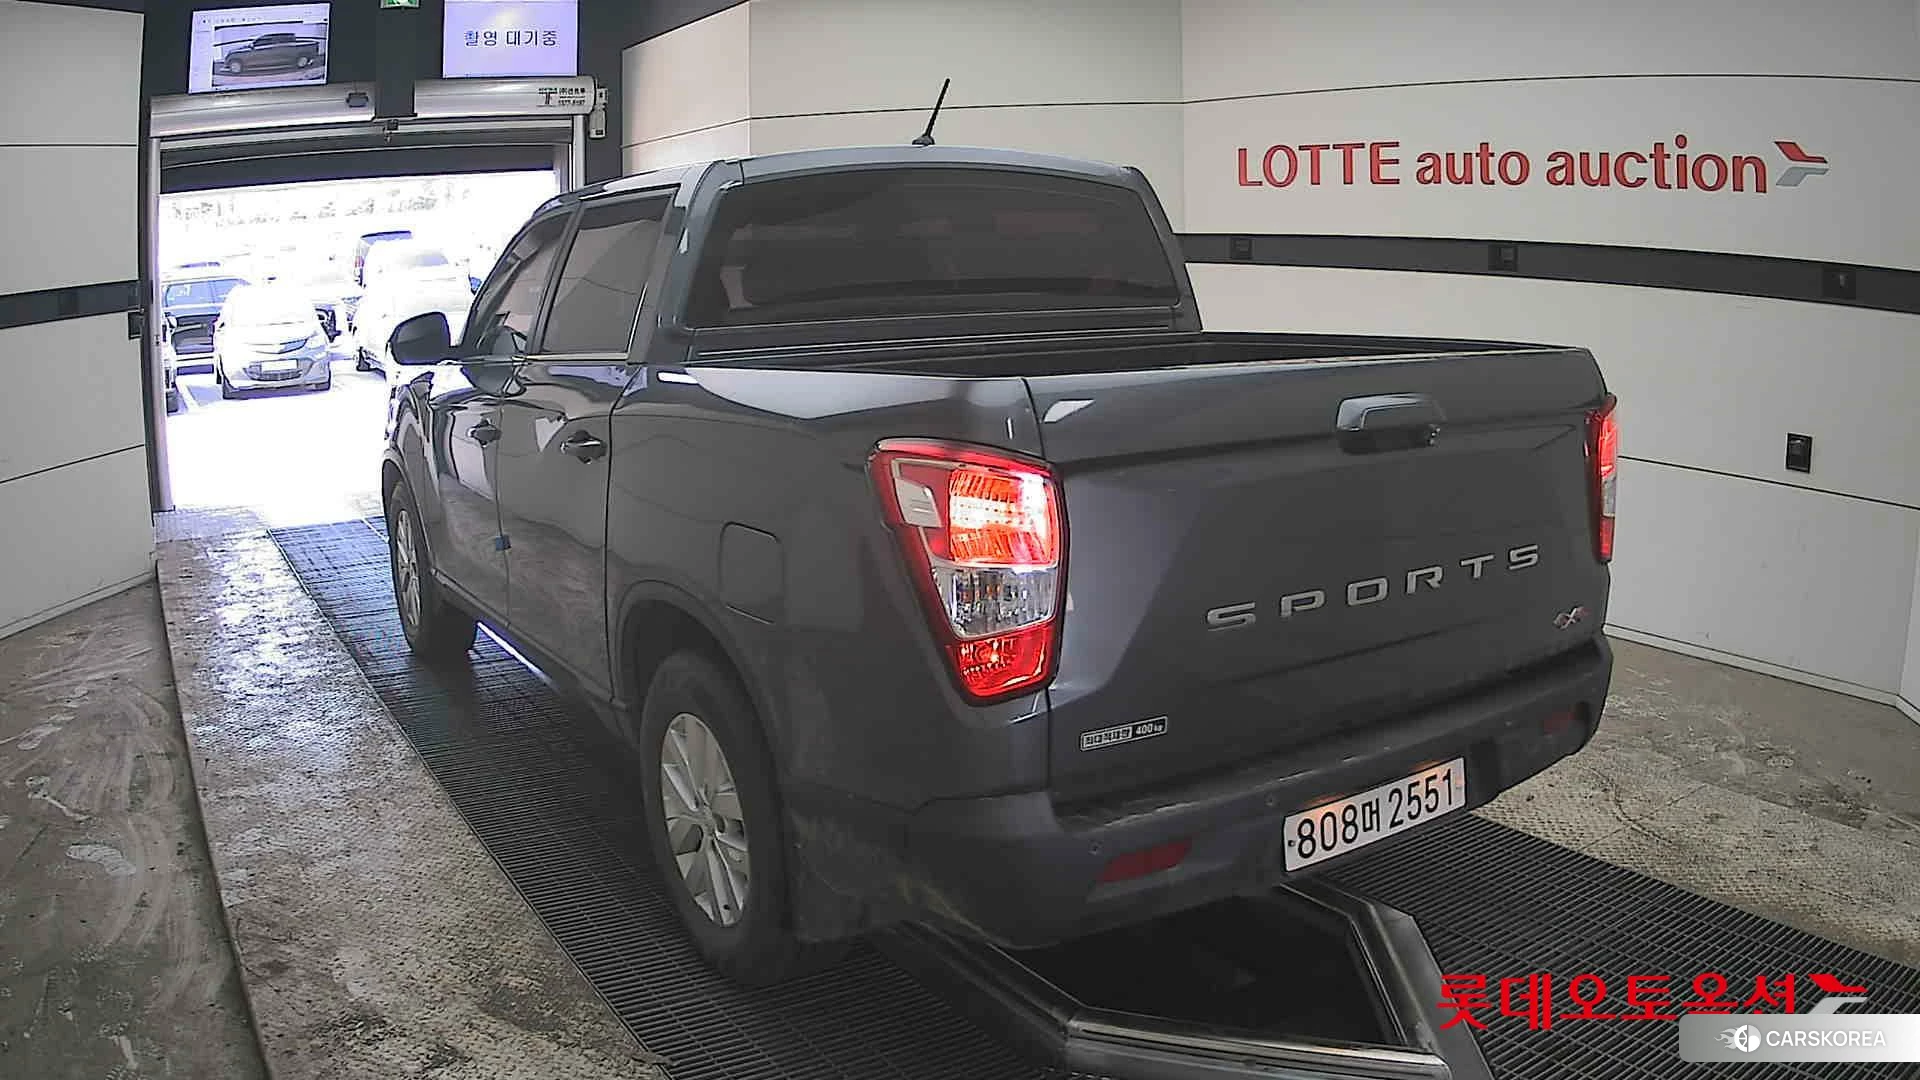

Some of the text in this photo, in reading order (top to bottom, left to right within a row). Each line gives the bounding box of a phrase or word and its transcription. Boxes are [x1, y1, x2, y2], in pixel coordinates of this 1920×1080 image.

[463, 30, 558, 46] 촬영 대기중
[1238, 134, 1768, 193] LOTTE auto auction
[1206, 544, 1539, 632] SPORTS
[1297, 768, 1452, 859] 808머 2551
